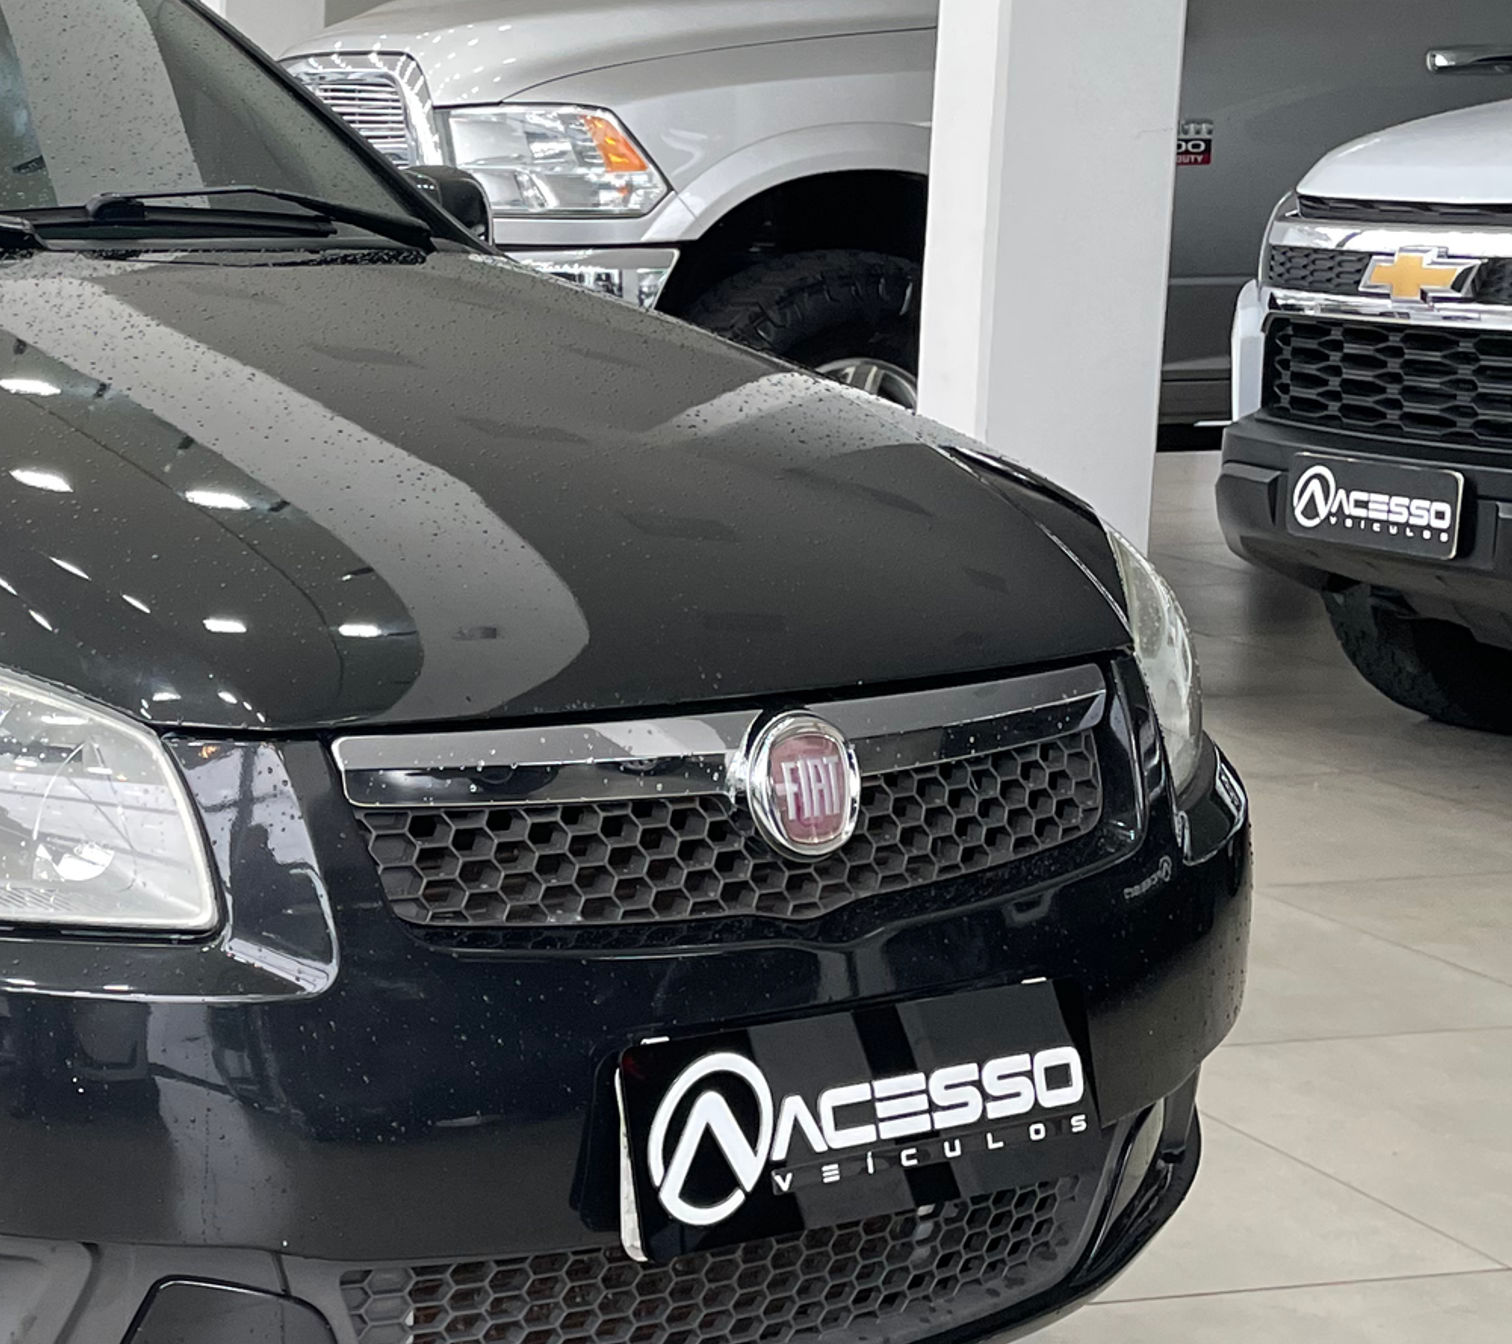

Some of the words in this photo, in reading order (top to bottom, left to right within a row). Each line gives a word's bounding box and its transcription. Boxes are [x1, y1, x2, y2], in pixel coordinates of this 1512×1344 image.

[1331, 488, 1451, 529] ACESSO
[781, 755, 841, 821] FIAT
[770, 1046, 1085, 1161] ACESSO
[771, 1113, 1088, 1192] VEÍCULOS
